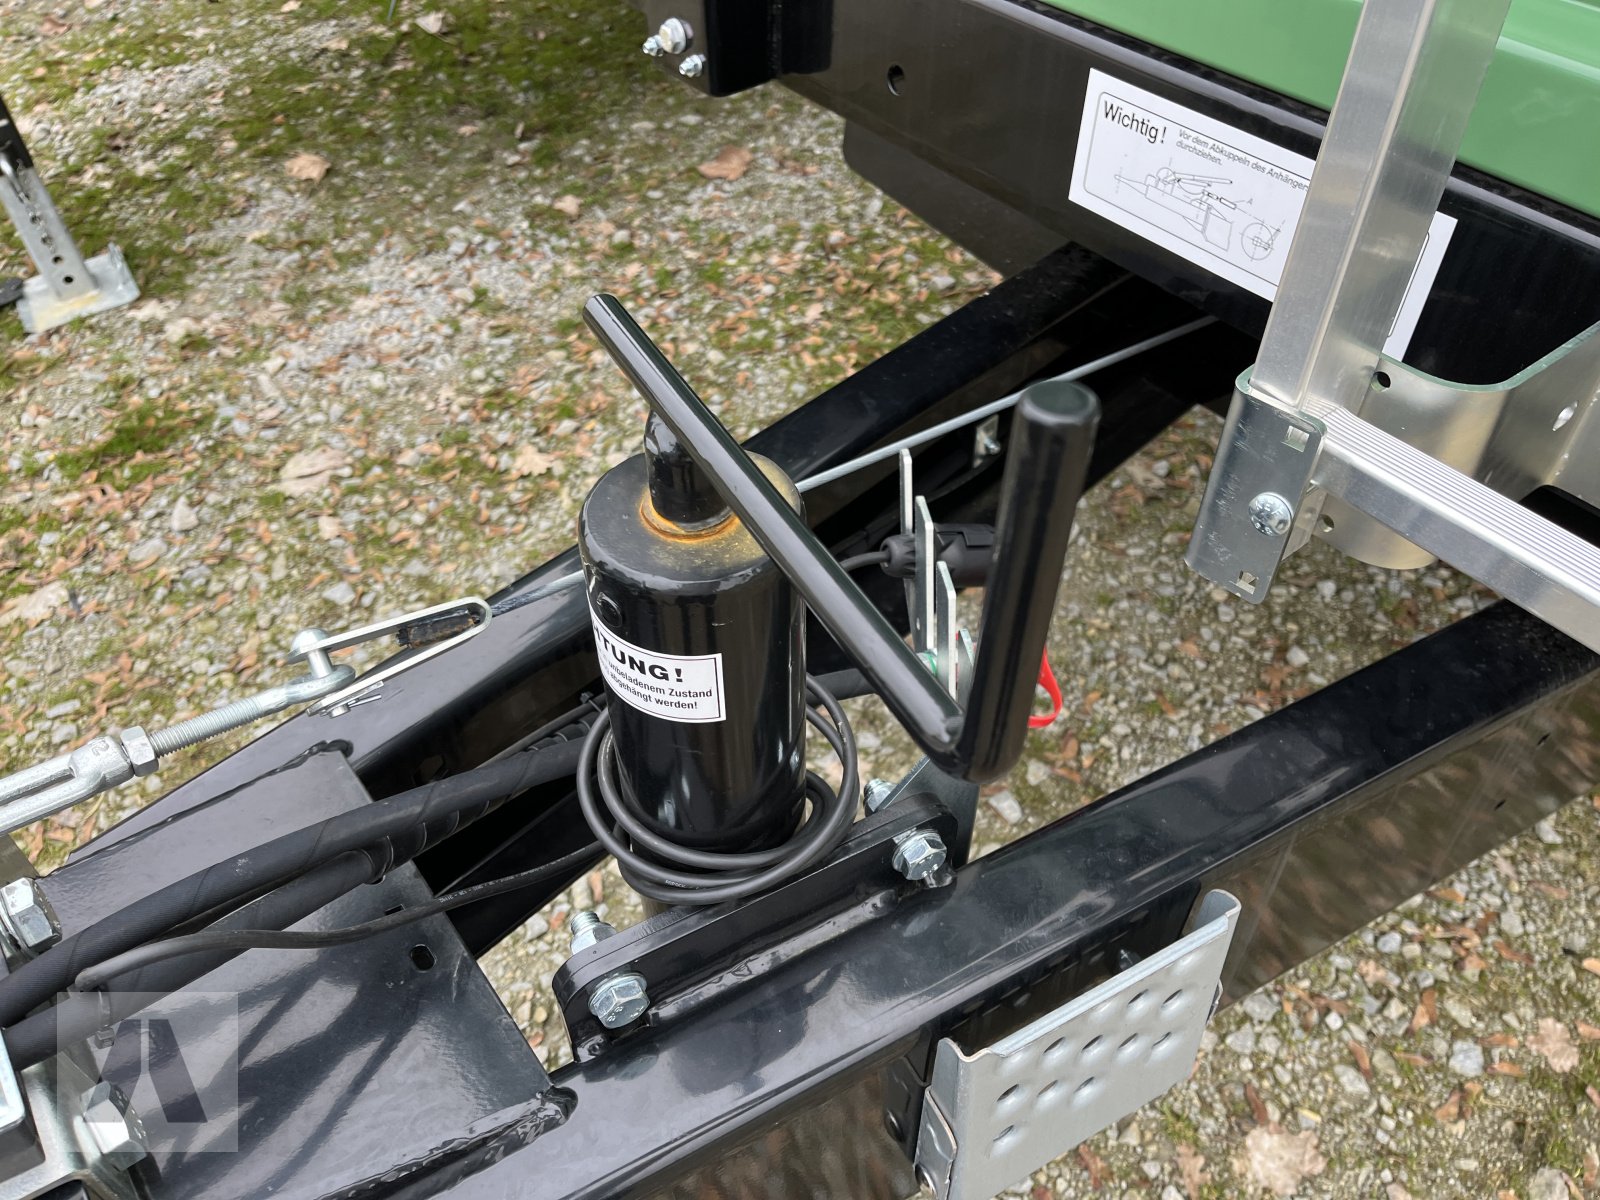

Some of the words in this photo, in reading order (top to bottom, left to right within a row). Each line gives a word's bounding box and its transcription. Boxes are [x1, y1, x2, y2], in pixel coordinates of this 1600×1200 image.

[1209, 143, 1250, 167] Abkuppeln
[1250, 162, 1267, 174] des
[668, 686, 713, 698] Zustand
[654, 697, 698, 709] werden!
